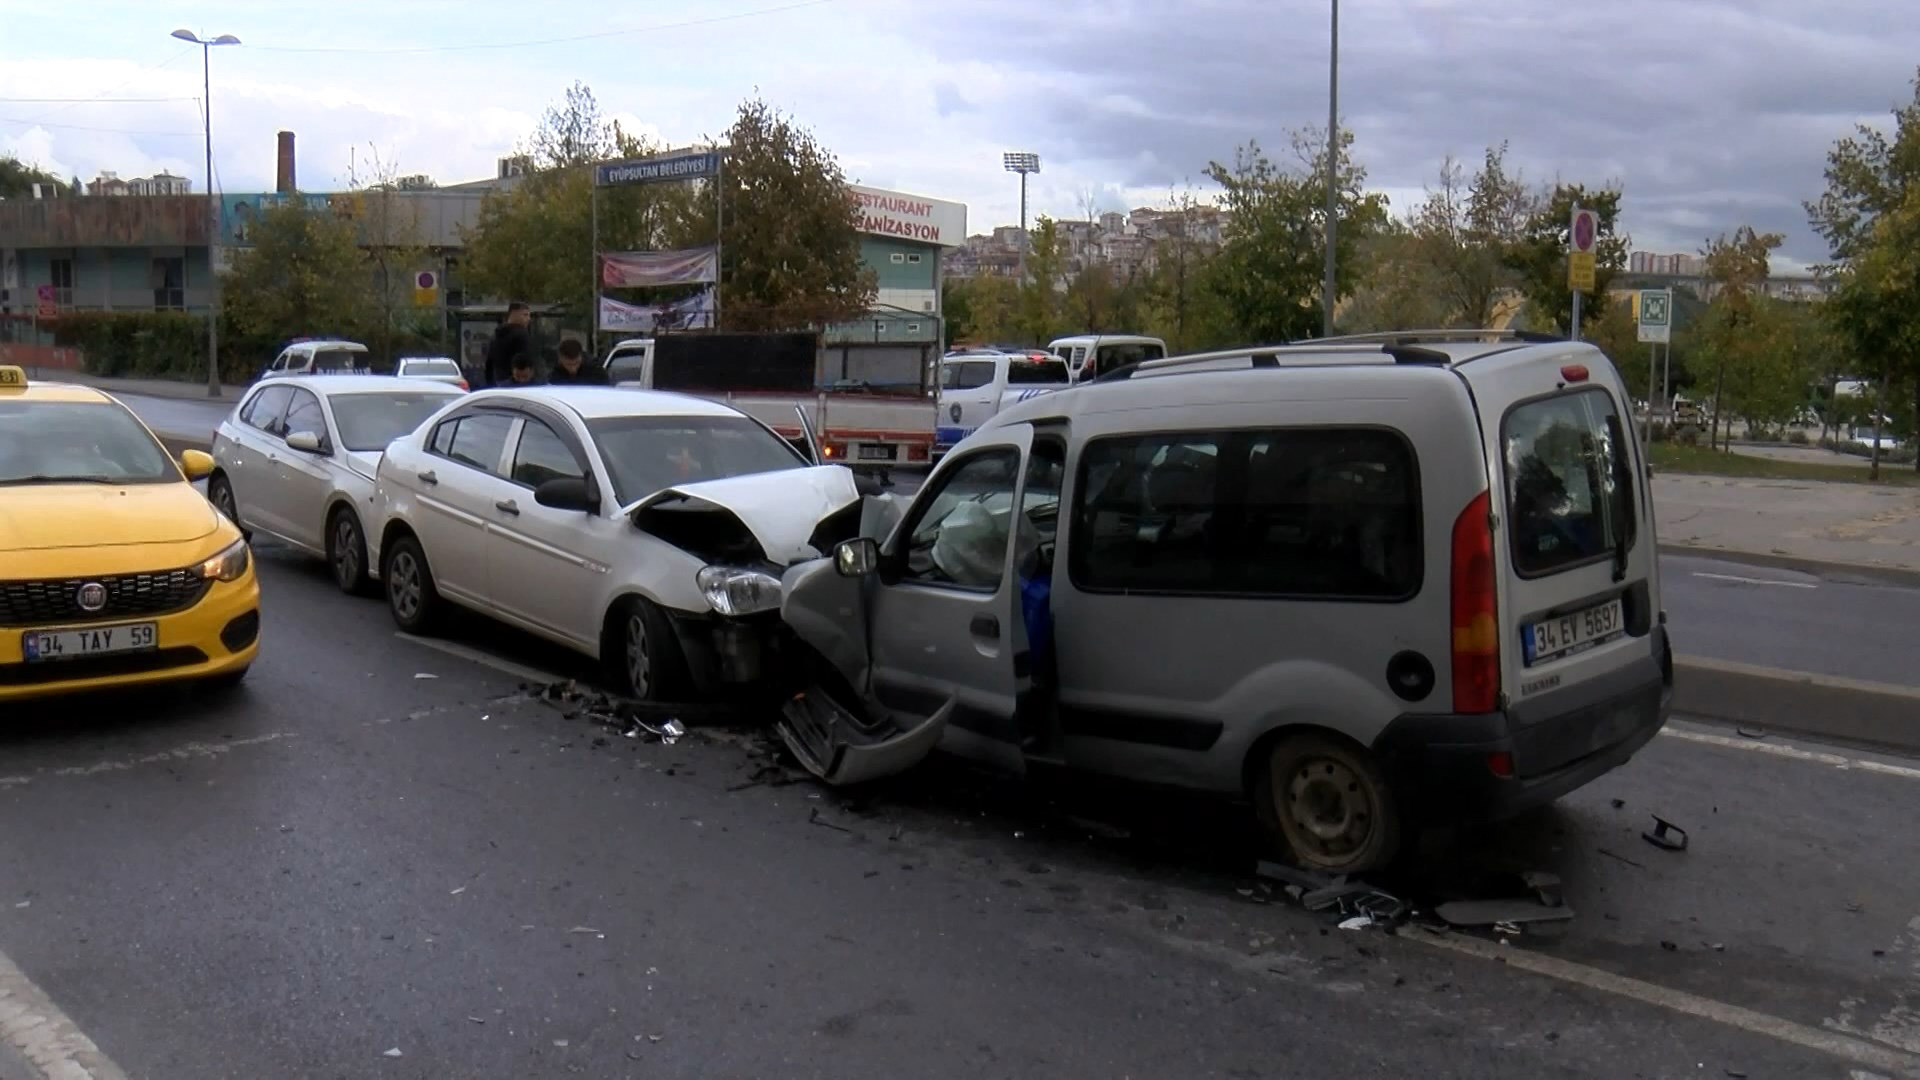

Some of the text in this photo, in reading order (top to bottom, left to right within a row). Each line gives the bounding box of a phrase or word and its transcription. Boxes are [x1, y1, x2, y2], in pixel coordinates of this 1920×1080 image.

[609, 157, 706, 182] EYÜPSULTAN BELEDİYESİ
[40, 626, 152, 654] 34 TAY 59
[1536, 603, 1617, 652] 34 EV 5697
